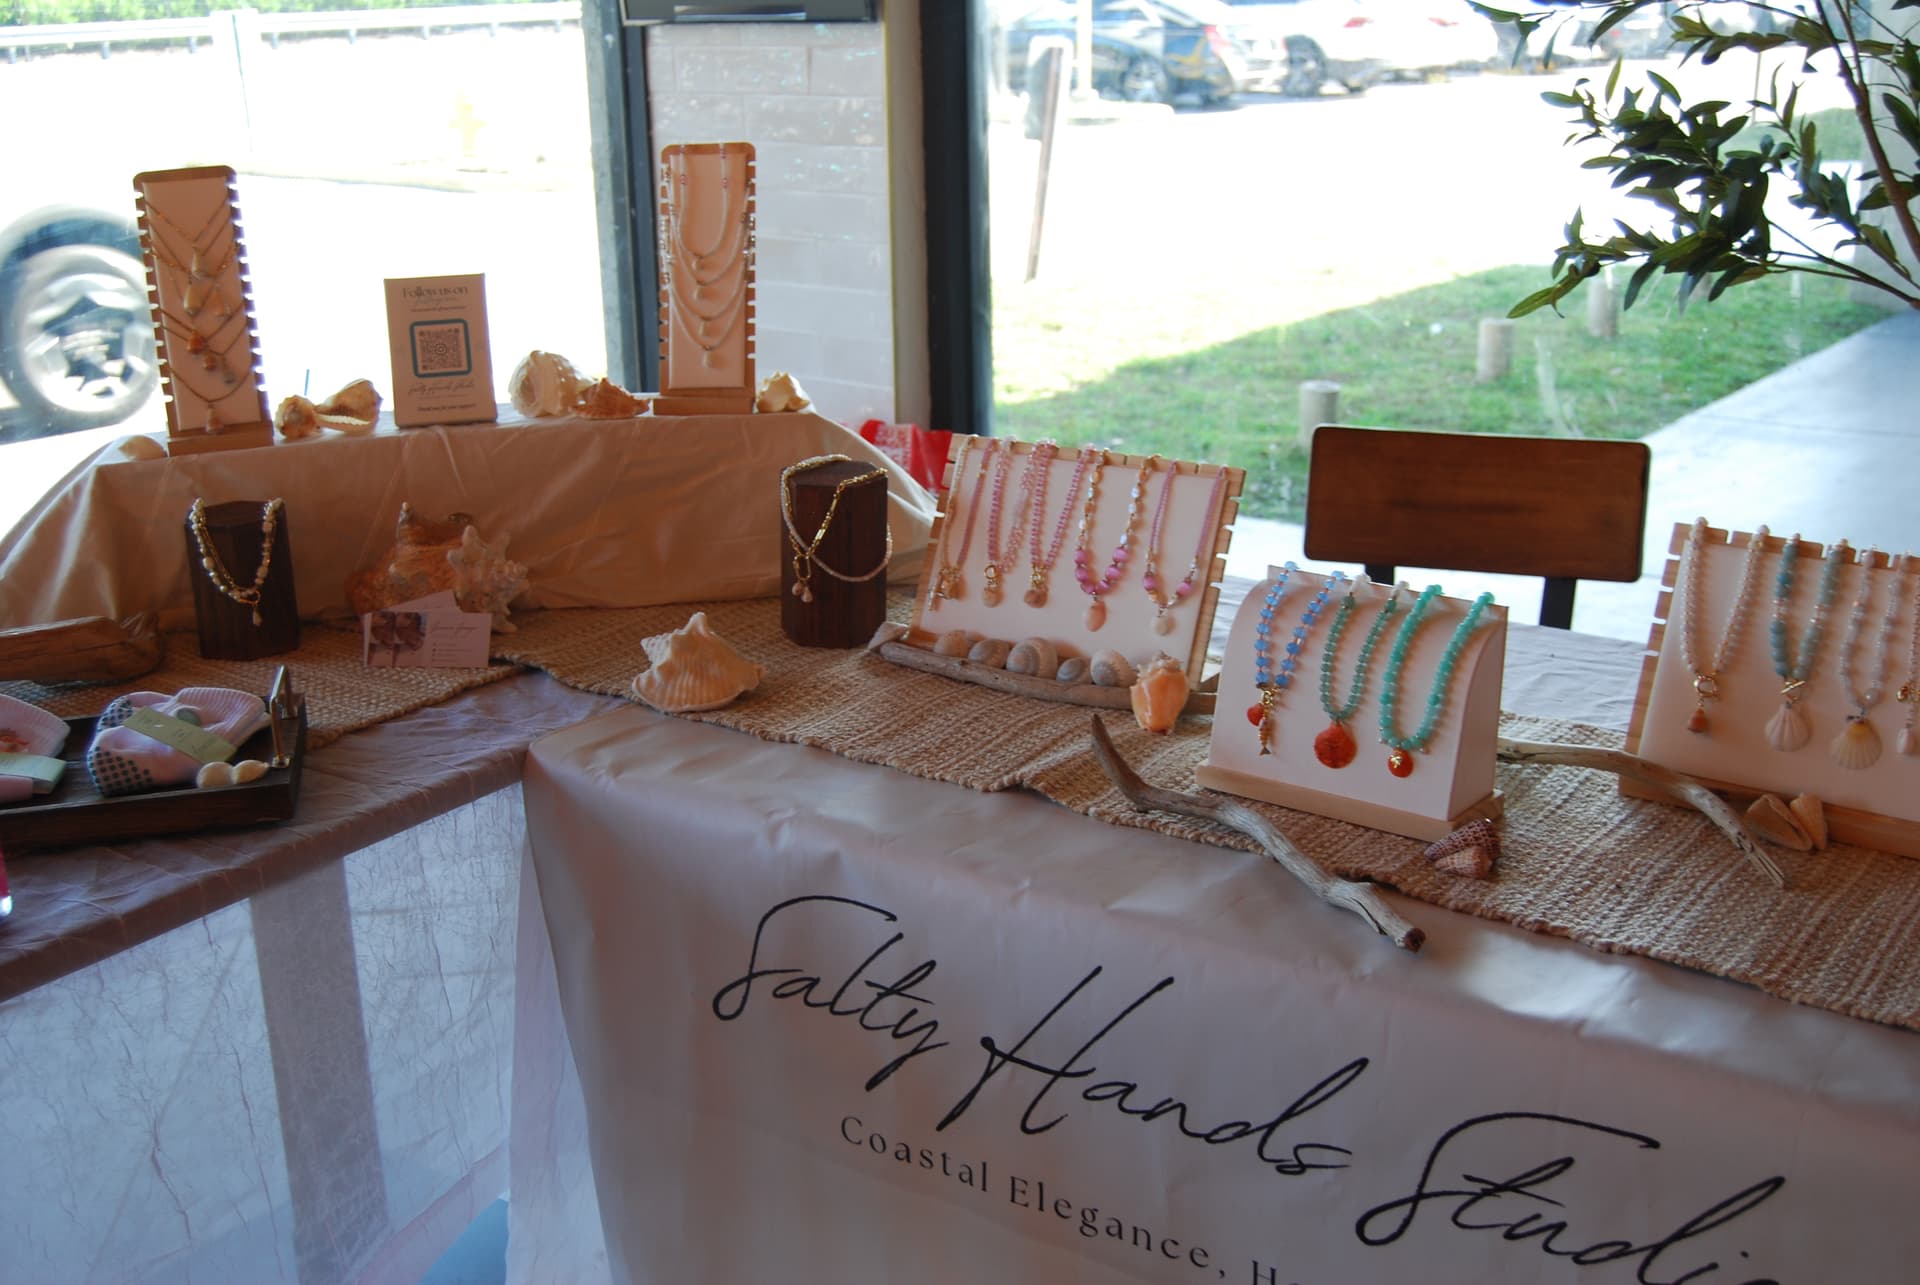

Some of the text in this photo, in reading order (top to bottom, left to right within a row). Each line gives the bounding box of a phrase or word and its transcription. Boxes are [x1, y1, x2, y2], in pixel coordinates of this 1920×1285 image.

[713, 895, 1786, 1285] Salty Hands Studi
[840, 1115, 989, 1193] Coastal
[1009, 1175, 1226, 1280] Elegance,
